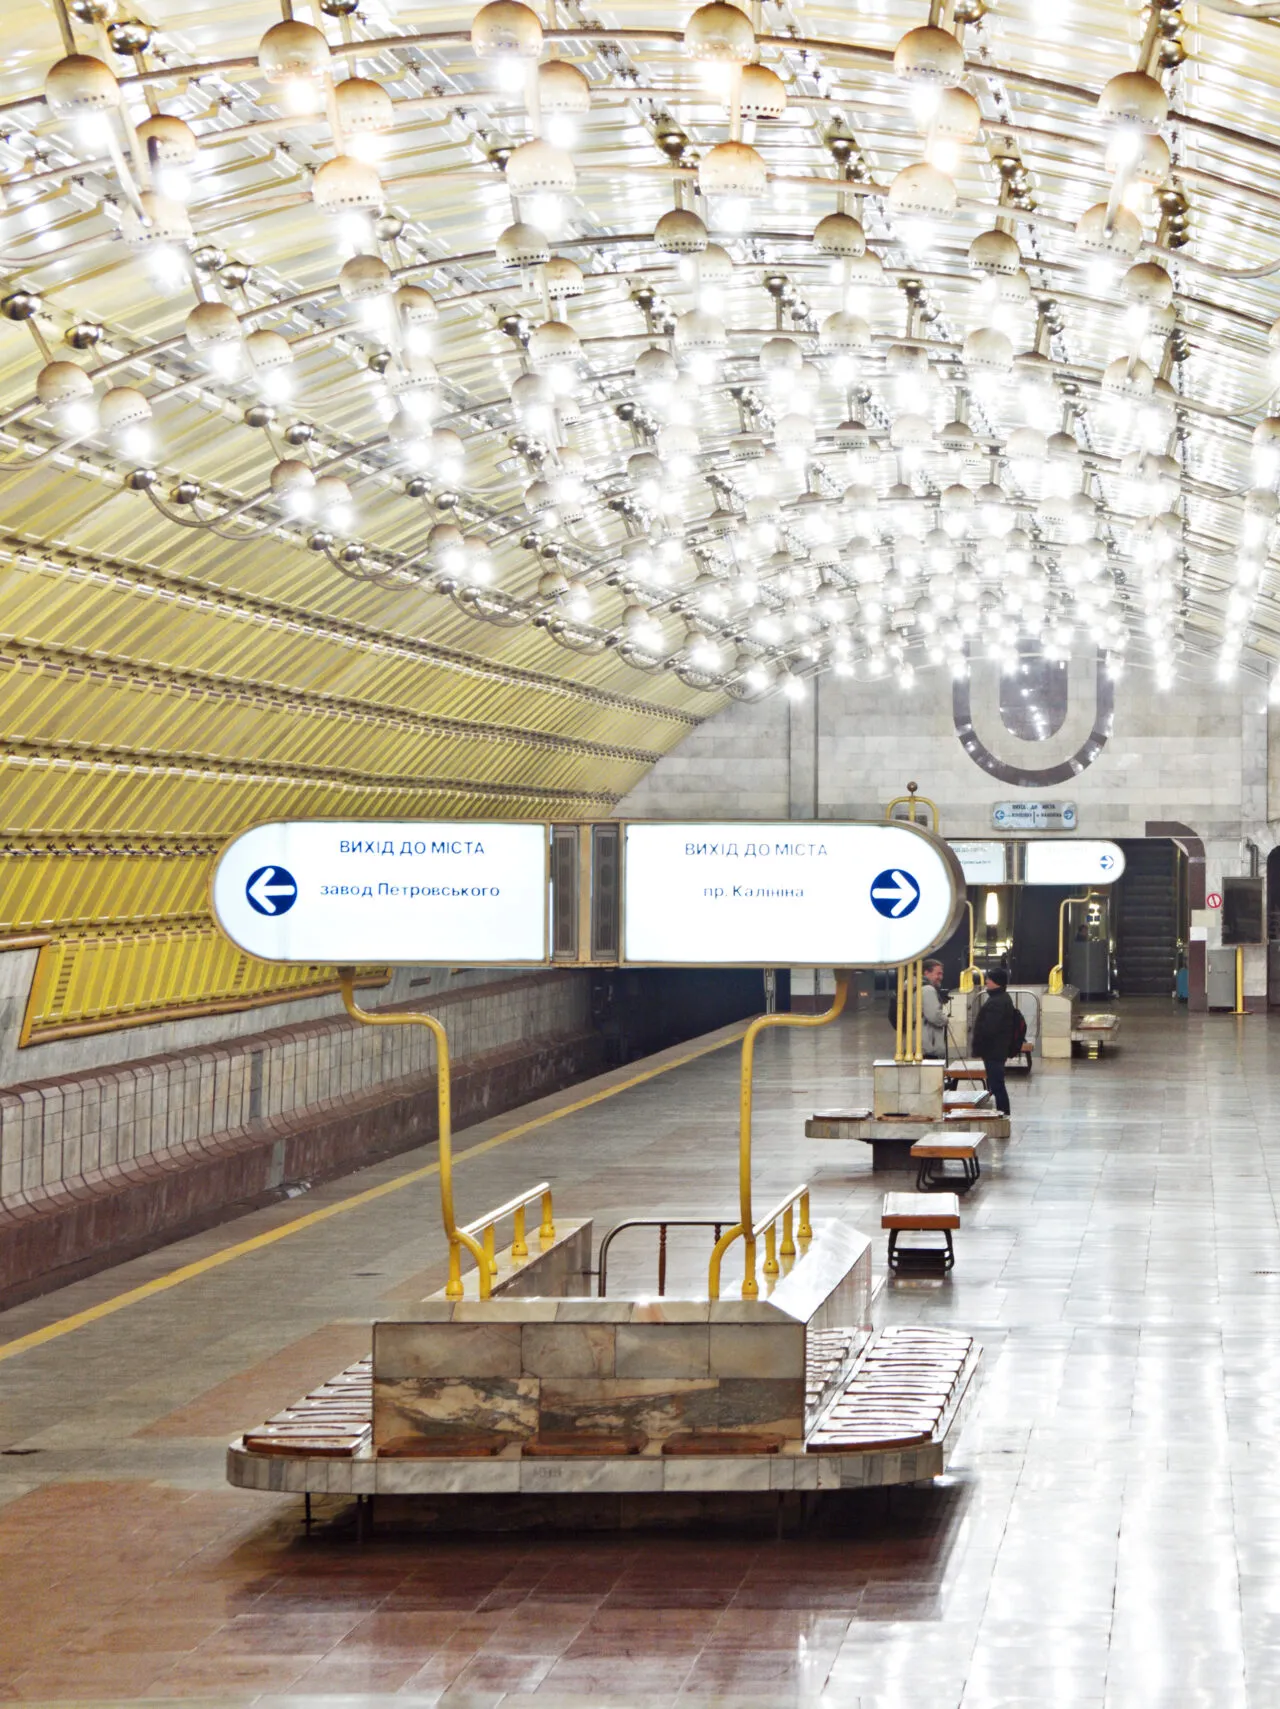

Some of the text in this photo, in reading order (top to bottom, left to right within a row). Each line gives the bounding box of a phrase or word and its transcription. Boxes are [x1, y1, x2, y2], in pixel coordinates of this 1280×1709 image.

[339, 840, 485, 856] ВИХІД ДО МІСТА
[685, 843, 828, 858] ВИХІД ДО МІСТА
[320, 882, 500, 899] завод Петровського
[703, 885, 804, 899] пр. Калініна
